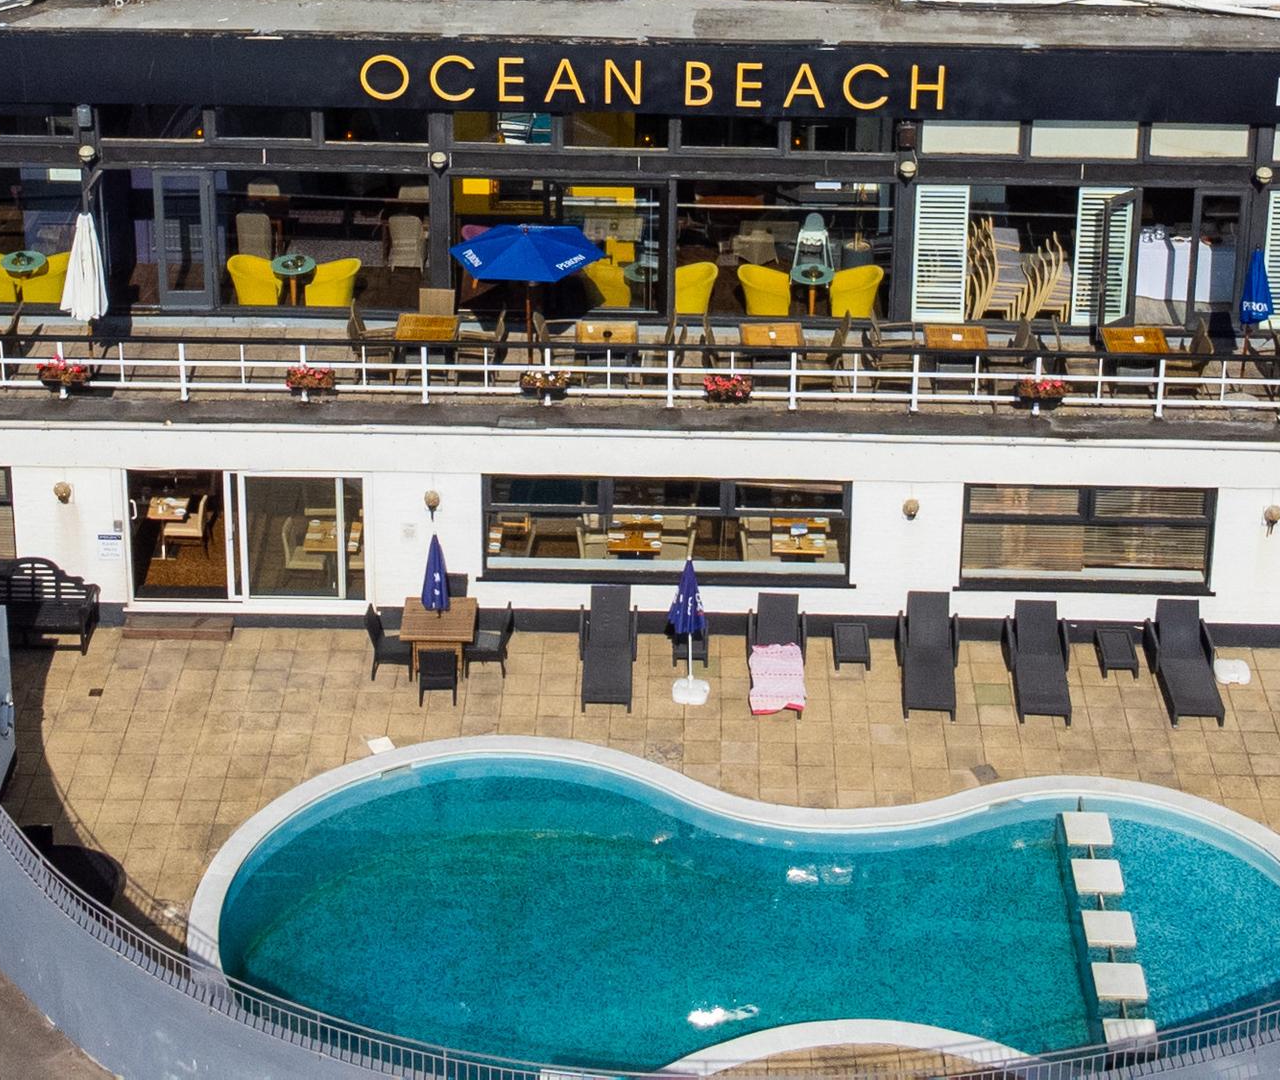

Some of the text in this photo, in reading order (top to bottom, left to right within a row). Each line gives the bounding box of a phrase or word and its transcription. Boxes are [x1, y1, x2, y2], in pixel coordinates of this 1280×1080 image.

[359, 54, 946, 110] OCEAN BEACH
[555, 253, 586, 271] PERONI
